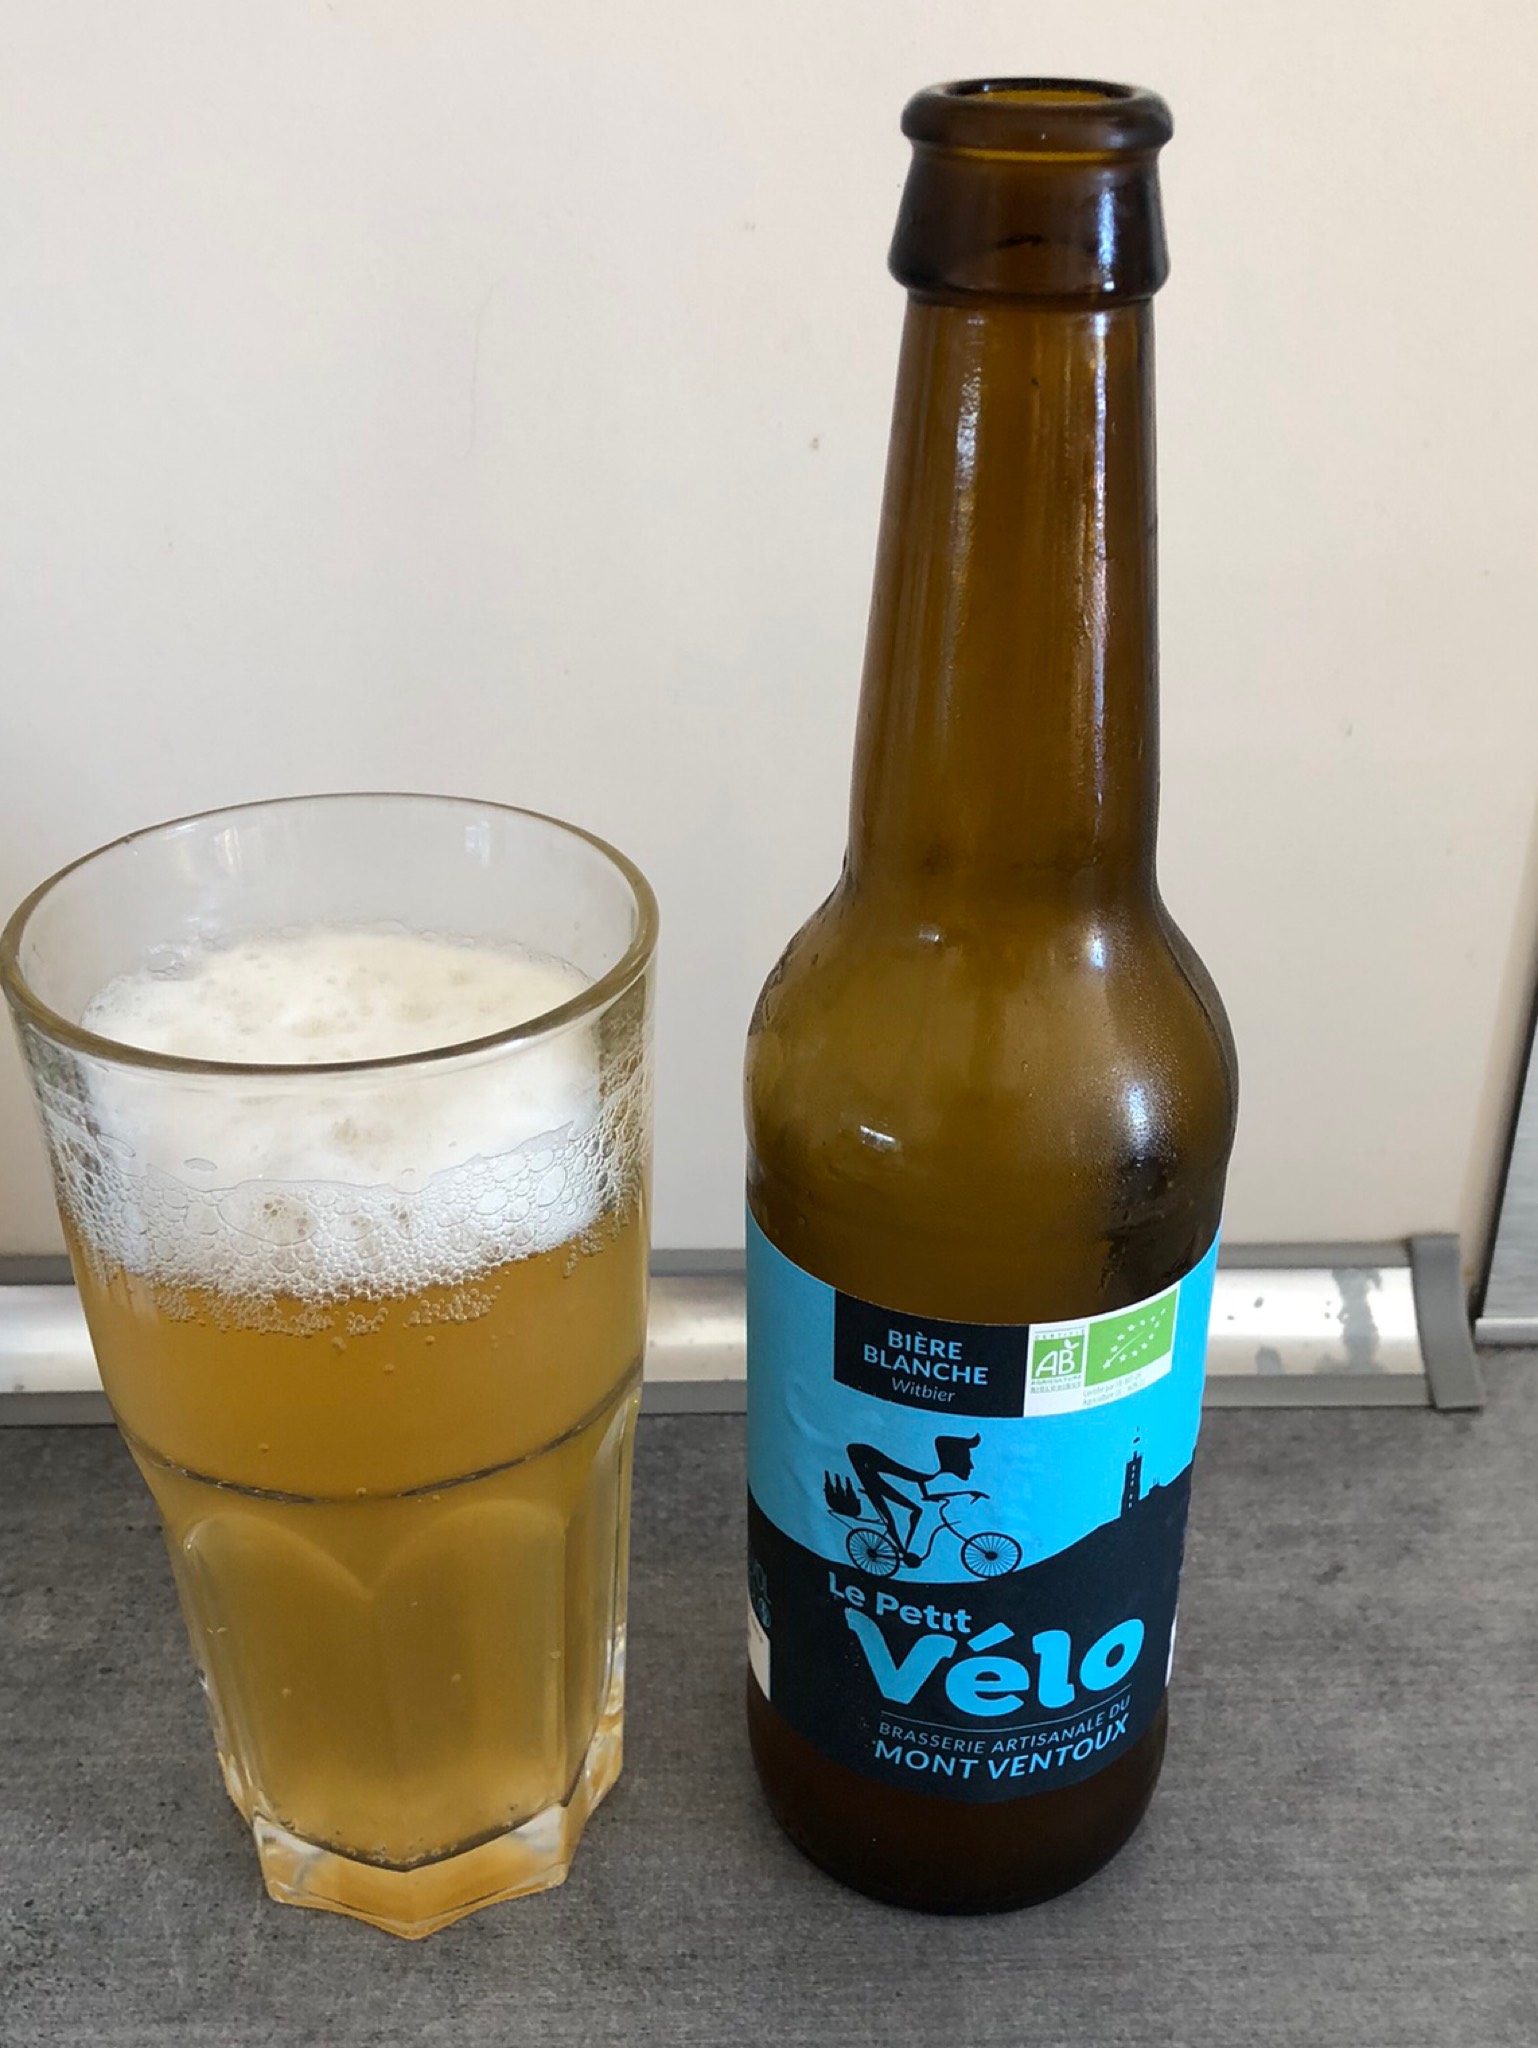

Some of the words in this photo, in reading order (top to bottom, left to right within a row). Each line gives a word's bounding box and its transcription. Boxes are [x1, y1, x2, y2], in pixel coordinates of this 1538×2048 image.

[863, 1344, 989, 1386] BLANCHE
[888, 1329, 963, 1360] BIÈRE
[1035, 1349, 1075, 1378] AB
[891, 1376, 955, 1403] Witbier
[828, 1571, 866, 1608] Le
[876, 1591, 972, 1634] Petit
[844, 1607, 1145, 1717] Vélo
[874, 1739, 979, 1780] MONT
[988, 1712, 1130, 1780] VENTOUX
[879, 1721, 986, 1754] BRASSERIE
[991, 1714, 1104, 1754] ARTISANALE
[1109, 1694, 1131, 1721] DU
